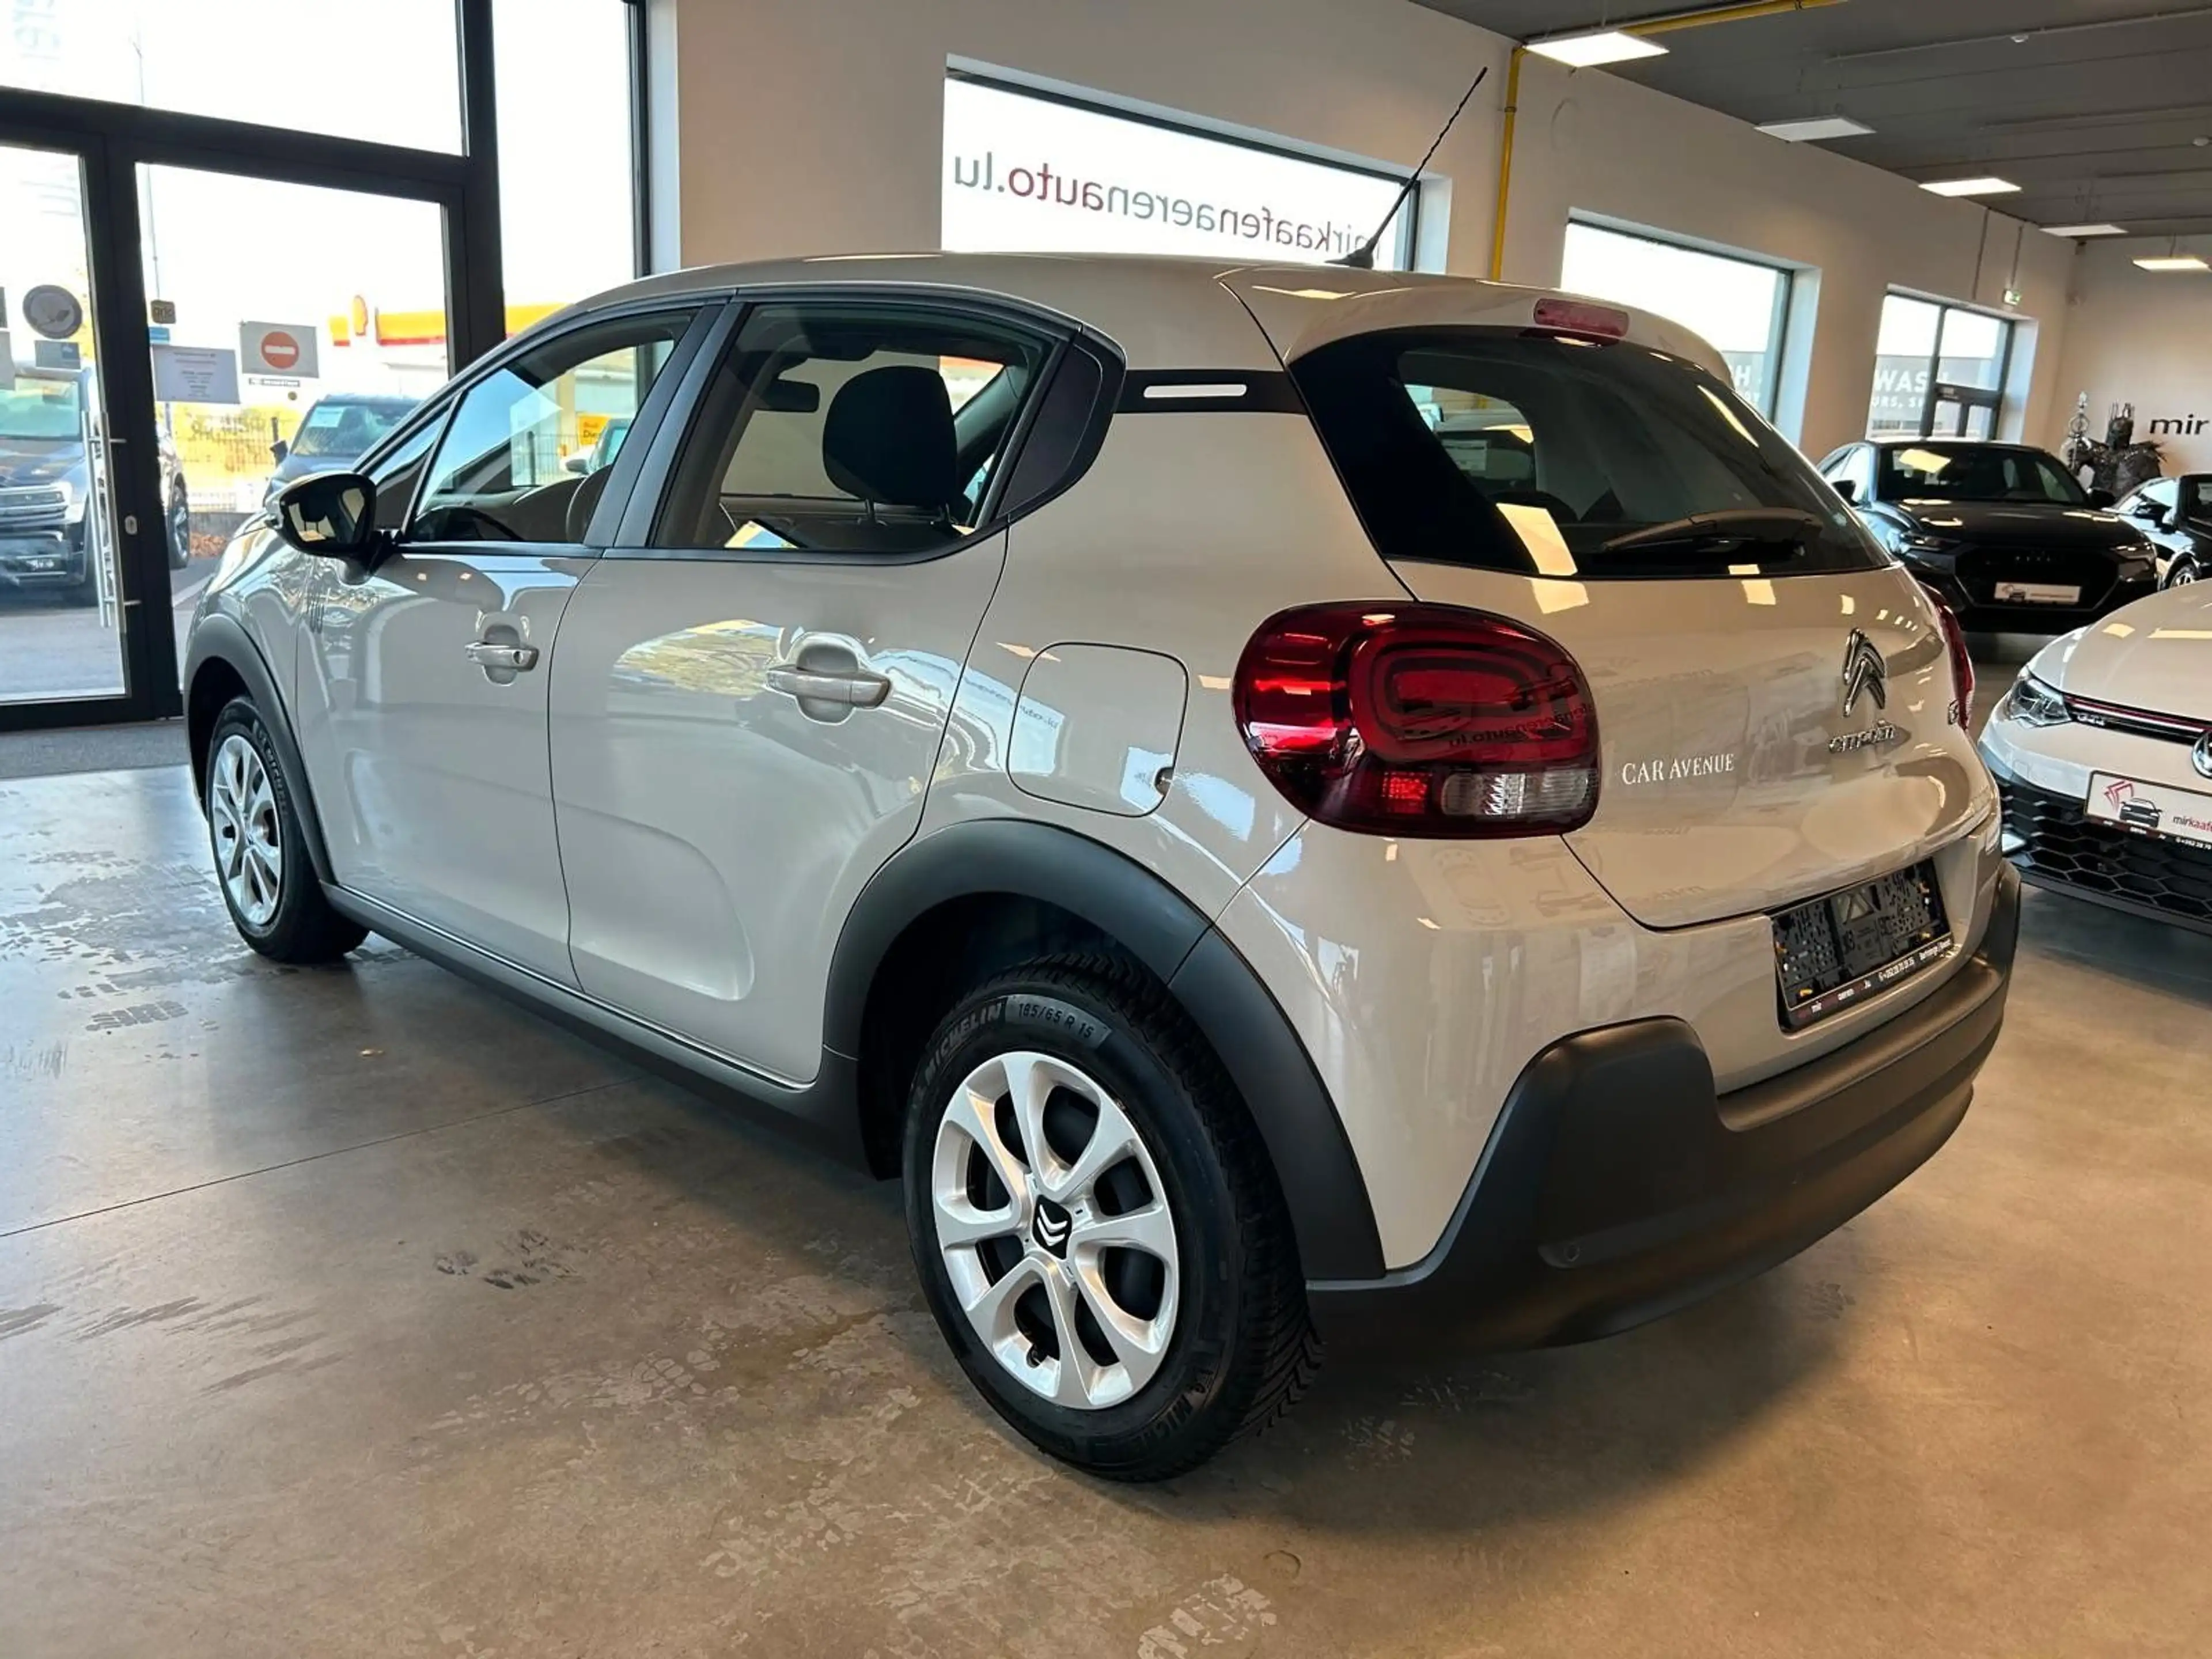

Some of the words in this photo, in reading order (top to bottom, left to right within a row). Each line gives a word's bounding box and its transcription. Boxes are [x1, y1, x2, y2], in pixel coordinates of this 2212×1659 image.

[2150, 414, 2210, 434] mir
[1622, 759, 1664, 785] CAR
[1669, 753, 1735, 780] AVENUE
[1018, 1003, 1063, 1024] 185/65
[1078, 1022, 1094, 1039] 15
